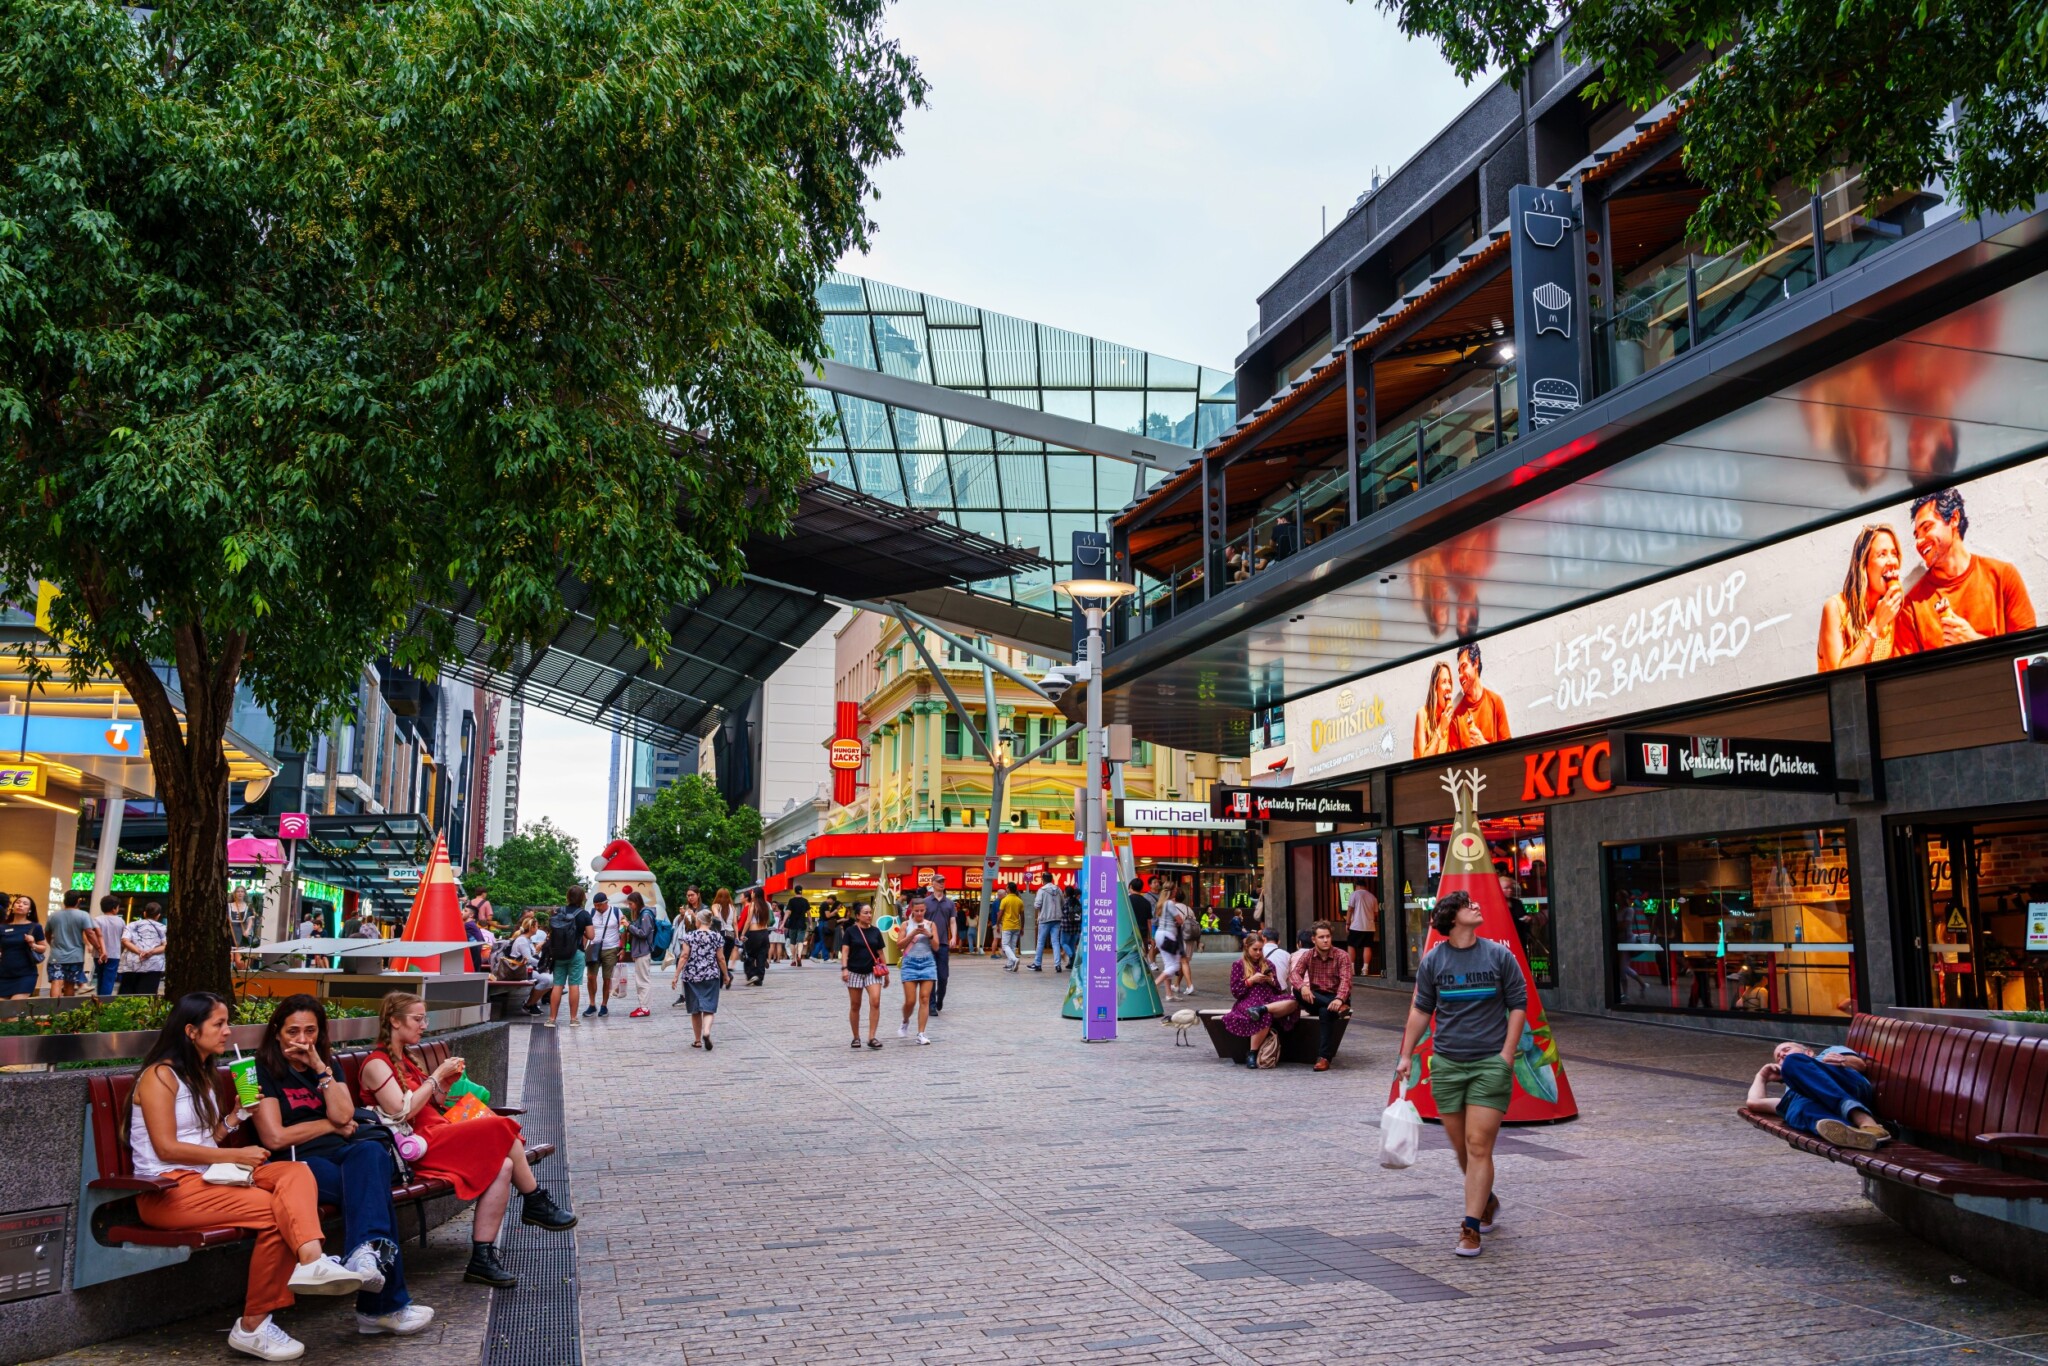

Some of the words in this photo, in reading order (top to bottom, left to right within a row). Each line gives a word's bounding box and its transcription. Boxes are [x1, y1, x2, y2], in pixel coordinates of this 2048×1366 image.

[1554, 624, 1616, 676] LET'S
[1621, 585, 1702, 649] CLEAN
[1706, 570, 1747, 617] UP
[1556, 668, 1608, 711] OUR
[1610, 615, 1750, 696] BACKYARD
[1311, 694, 1386, 753] Drumstick
[1521, 741, 1612, 801] KFC
[1679, 748, 1735, 774] Kentucky
[1737, 752, 1767, 773] Fried
[1135, 807, 1207, 822] michael
[1257, 796, 1295, 812] Kentucky
[1296, 797, 1316, 811] Fried
[1094, 908, 1113, 916] CALM
[1465, 970, 1496, 983] KIRRA
